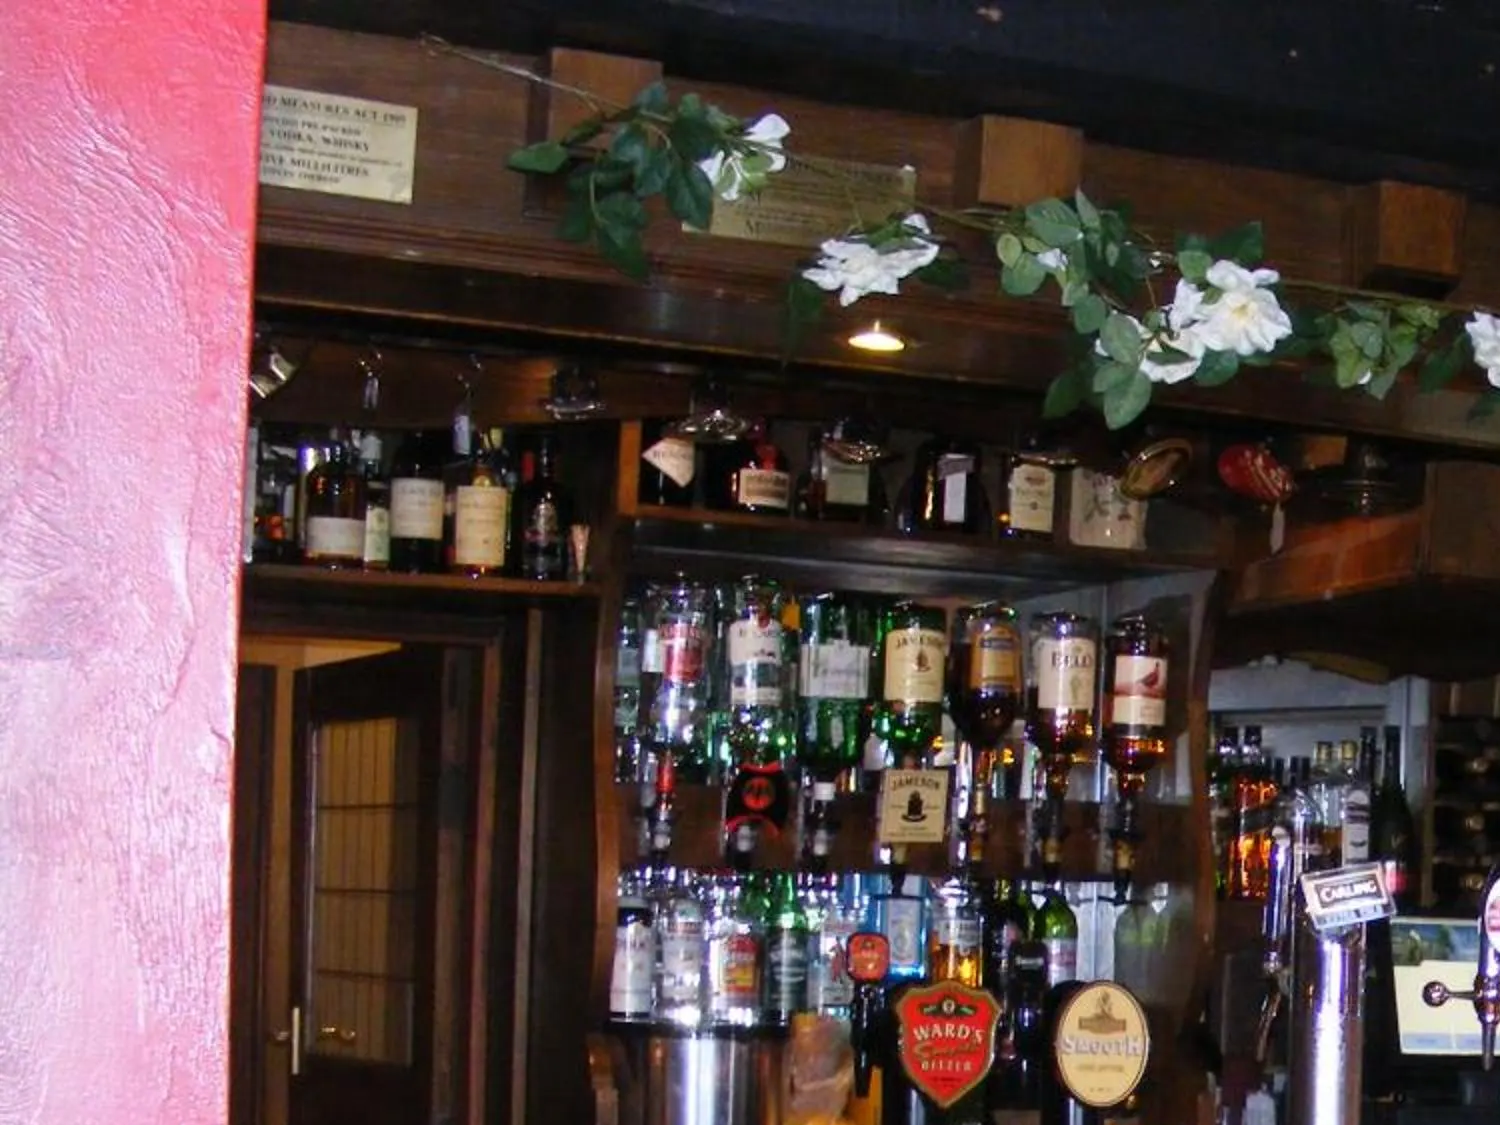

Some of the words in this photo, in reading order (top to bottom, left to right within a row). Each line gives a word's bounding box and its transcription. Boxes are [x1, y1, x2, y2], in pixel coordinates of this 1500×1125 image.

[890, 774, 941, 792] JAMESON
[1320, 879, 1377, 903] CARLING
[913, 1023, 986, 1045] WARD'S
